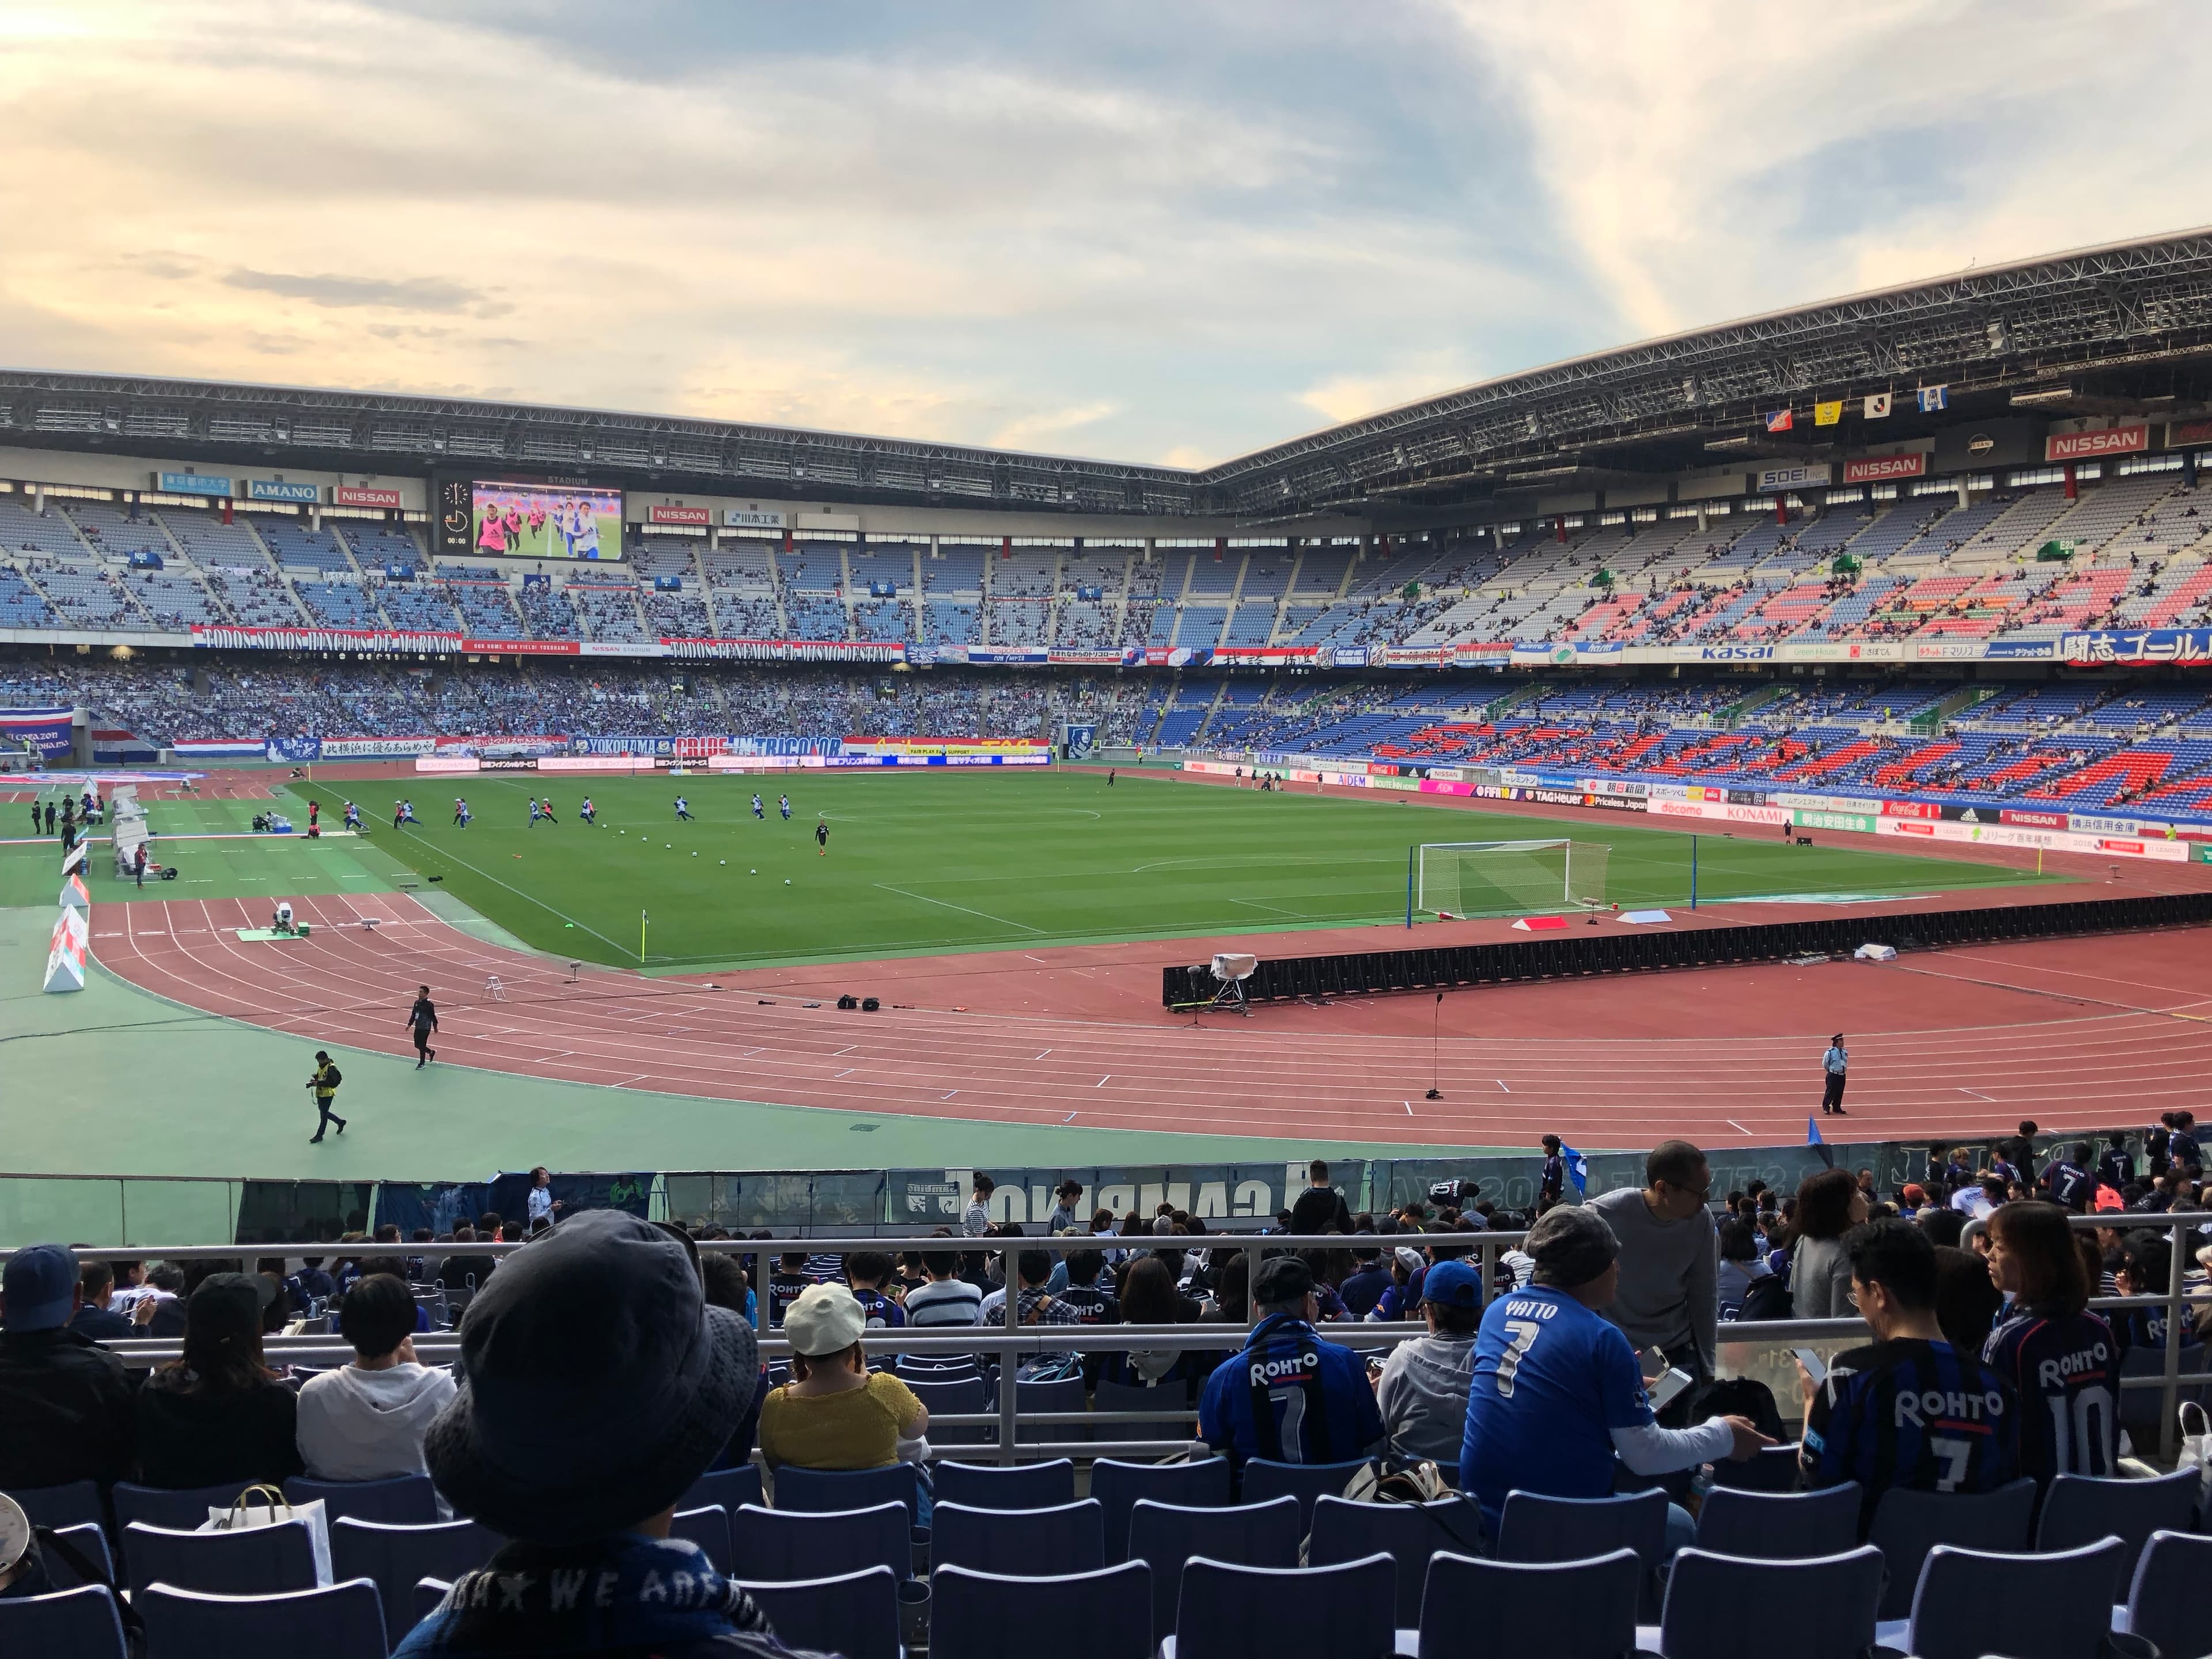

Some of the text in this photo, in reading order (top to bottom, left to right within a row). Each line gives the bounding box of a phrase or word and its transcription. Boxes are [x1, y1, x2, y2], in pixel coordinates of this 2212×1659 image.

[2056, 431, 2138, 454] NISSAN
[1851, 459, 1917, 478] NISSAN
[547, 475, 588, 486] STADIUM
[253, 484, 315, 499] AMANO
[342, 491, 396, 504] NISSAN
[657, 510, 706, 521] NISSAN
[202, 628, 457, 653] TODOS SOMOS HINCHAS DE MARINOS
[670, 641, 713, 660] TODOS
[716, 643, 777, 660] TENEMOS
[782, 645, 797, 661] EL
[801, 645, 844, 662] MISMO
[844, 645, 893, 662] DESTINO
[1794, 648, 1815, 656] Green
[1866, 647, 1891, 656] さぼてん
[671, 676, 684, 684] N13
[590, 739, 656, 754] YOKOHAMA
[675, 737, 729, 757] PRIDE
[754, 737, 843, 757] TRICOLOR
[1339, 774, 1365, 787] AIDEM
[1607, 782, 1646, 794] 朝日新聞
[1655, 787, 1687, 797] スポーツくじ
[1626, 800, 1647, 810] Japan
[1728, 806, 1783, 823] KONAMI
[1802, 813, 1867, 831] 明治安田生命
[2011, 813, 2057, 825] NISSAN
[2071, 819, 2136, 832] 横浜信用金庫
[2060, 1164, 2085, 1179] ROHTO
[2061, 1173, 2077, 1198] 7
[1505, 1299, 1559, 1320] YATTO
[1497, 1321, 1540, 1398] 7
[2039, 1342, 2108, 1388] ROHTO
[1250, 1352, 1319, 1388] ROHTO
[1895, 1391, 2004, 1428] ROHTO
[1269, 1385, 1307, 1464] 7
[2047, 1385, 2113, 1478] 10
[1930, 1437, 1972, 1493] 7
[550, 1569, 619, 1609] WE
